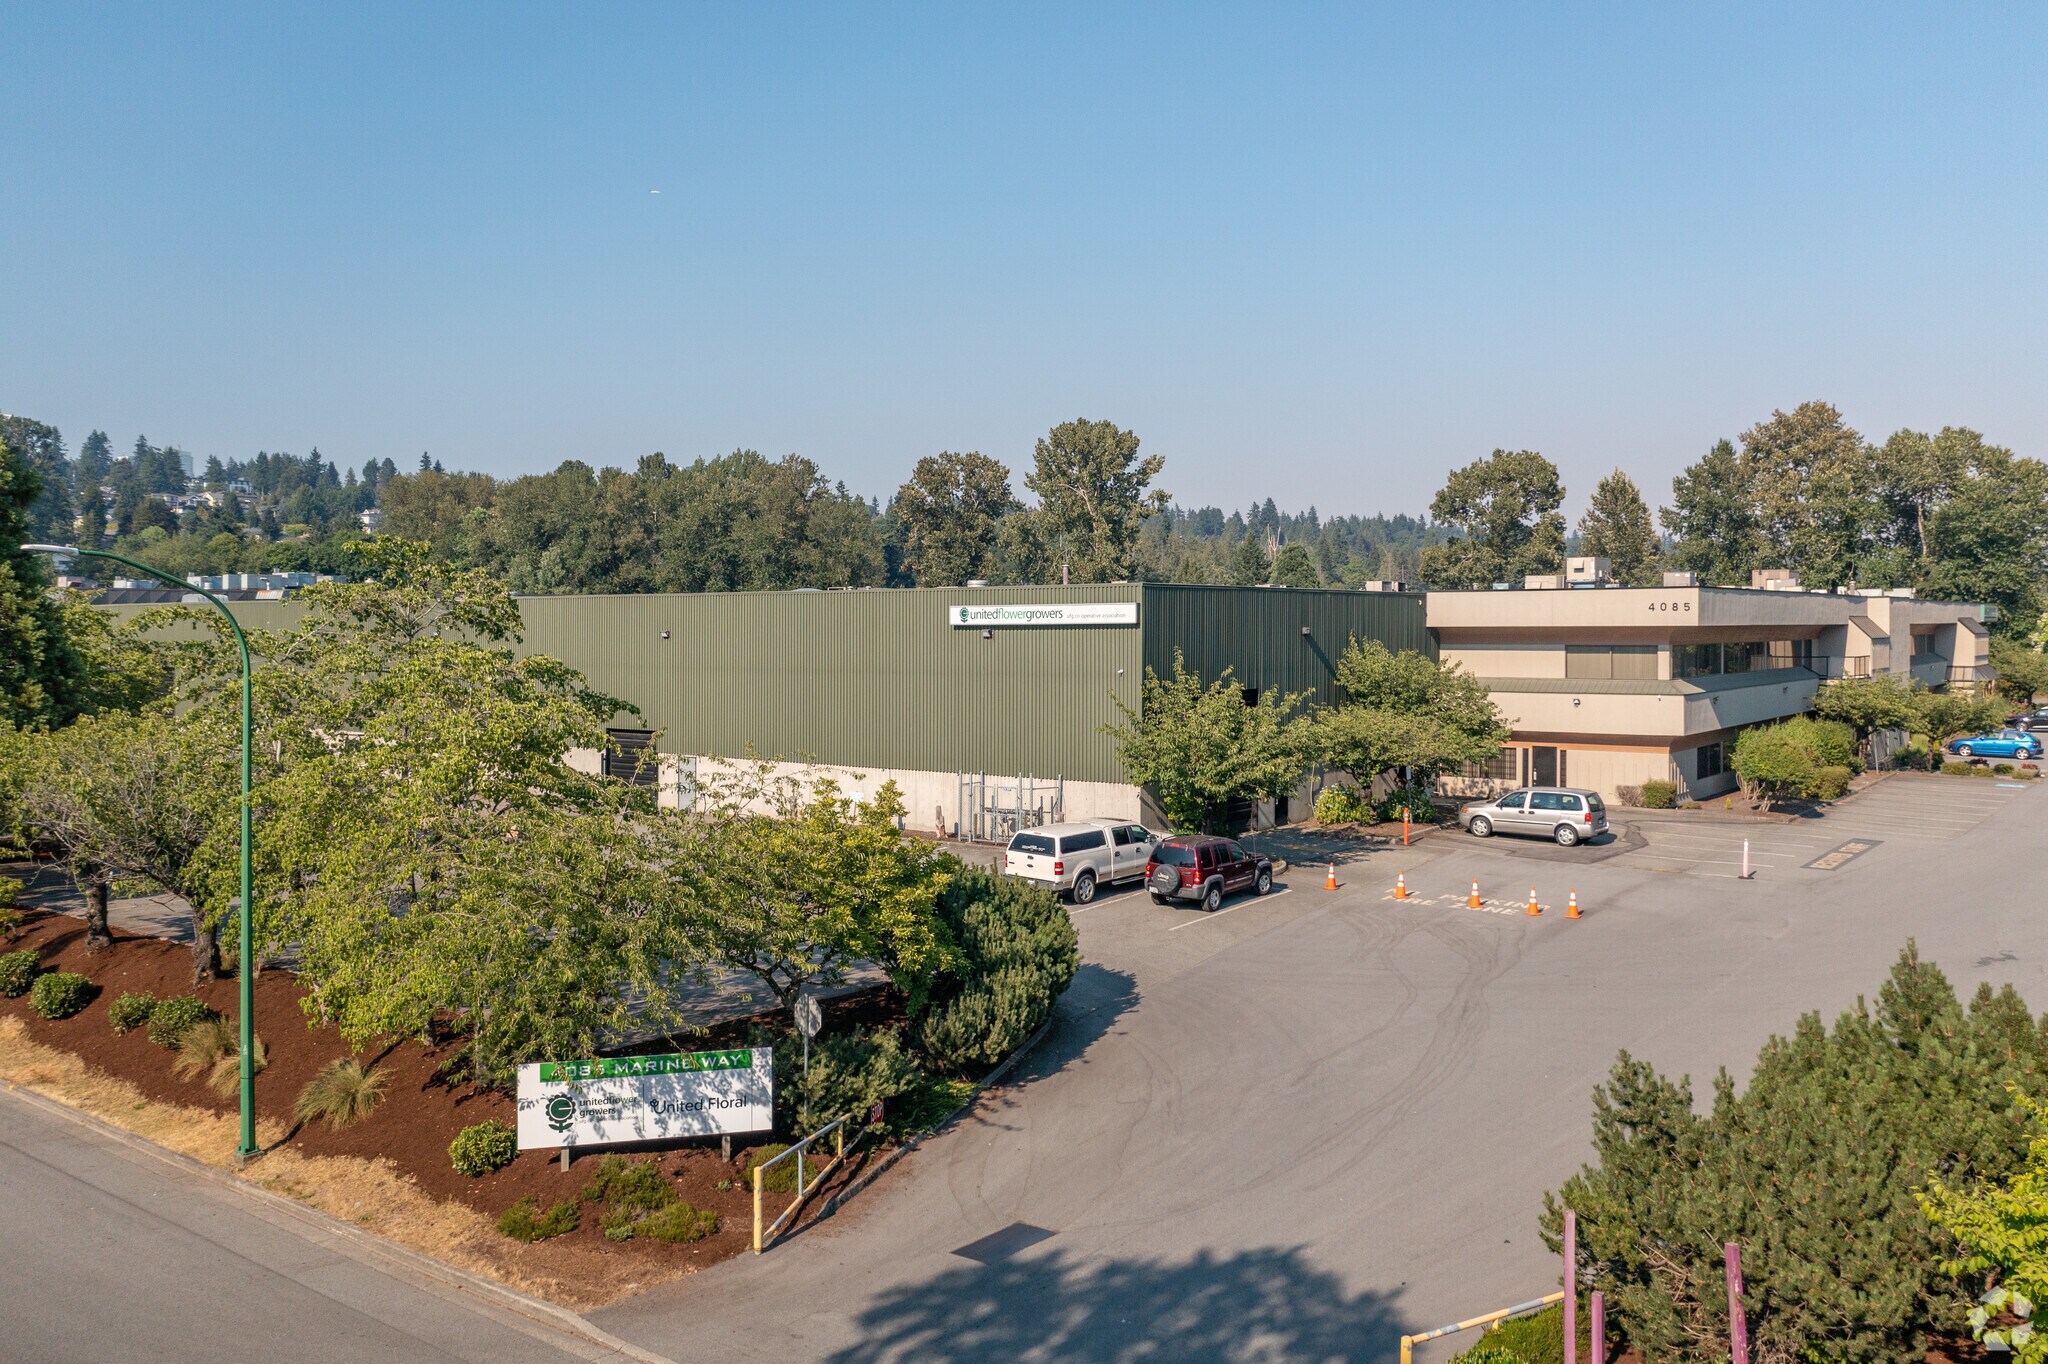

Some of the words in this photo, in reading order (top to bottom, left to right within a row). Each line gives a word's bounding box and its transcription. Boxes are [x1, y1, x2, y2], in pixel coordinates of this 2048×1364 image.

[1648, 602, 1691, 612] 4085
[970, 607, 1063, 622] unitedflowergrowers
[614, 1058, 693, 1075] MARINE
[701, 1054, 742, 1068] WAY
[580, 1096, 637, 1107] unitedflower
[650, 1098, 703, 1114] United
[708, 1095, 747, 1110] Floral
[580, 1107, 617, 1119] growers
